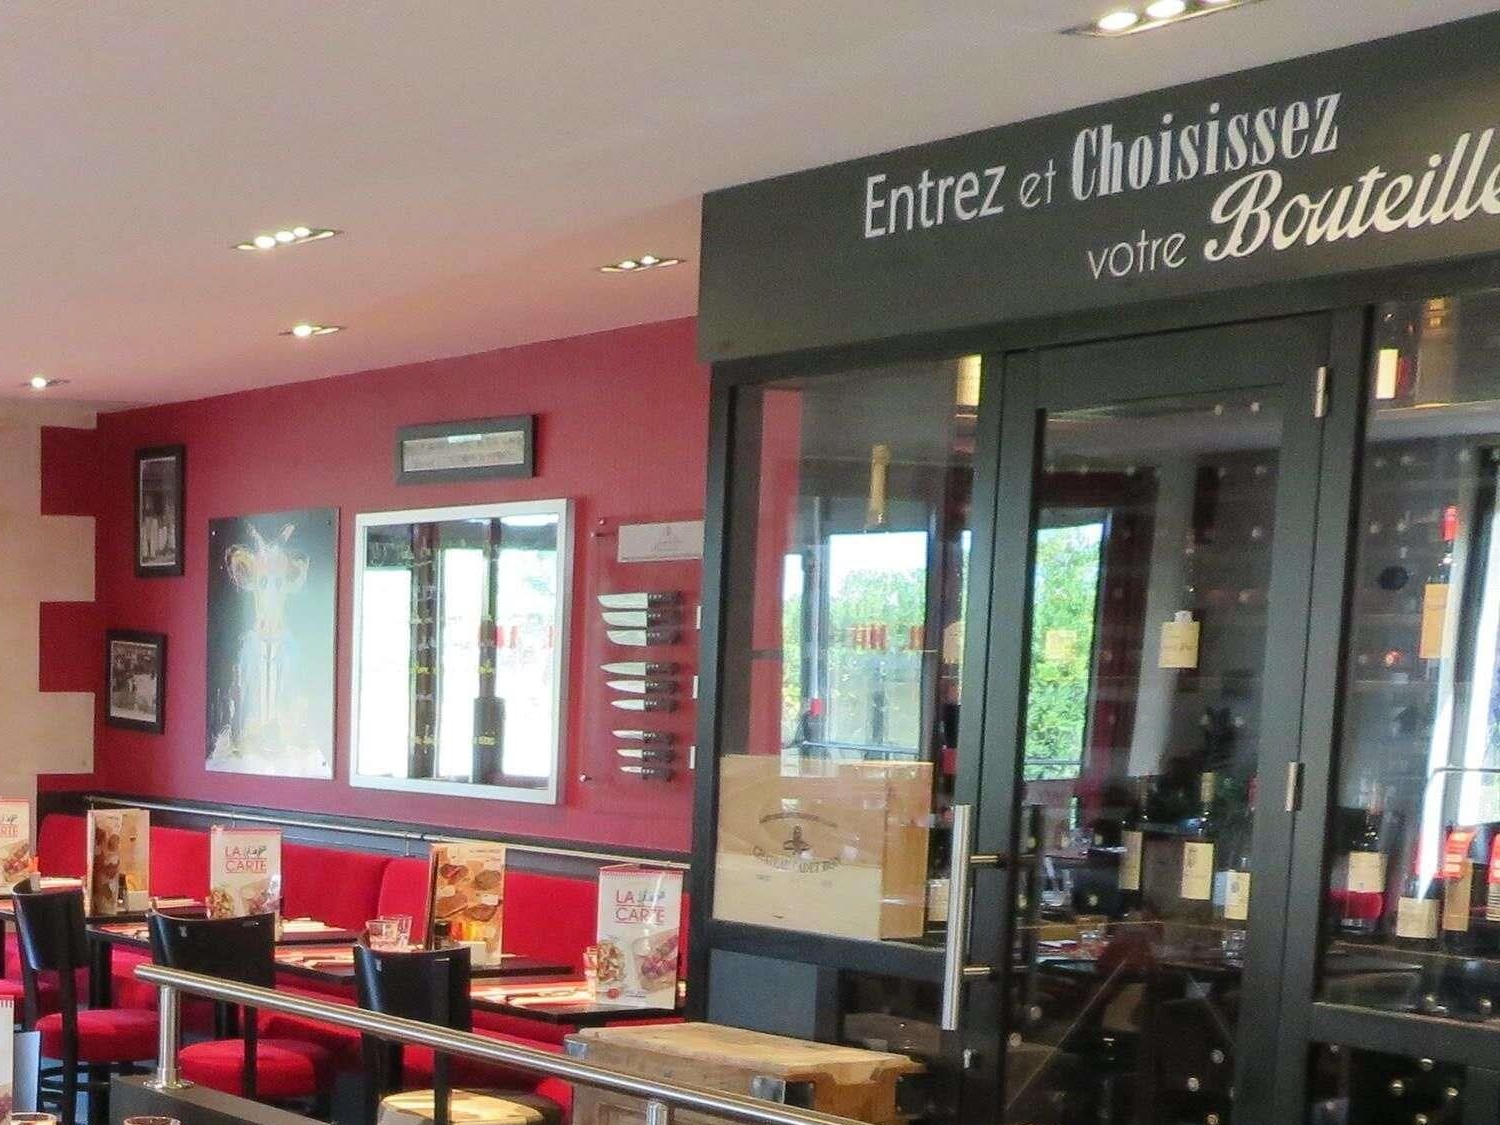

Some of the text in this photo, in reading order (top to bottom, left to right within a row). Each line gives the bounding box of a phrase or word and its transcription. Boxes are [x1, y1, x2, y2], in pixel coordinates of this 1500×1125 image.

[864, 92, 1341, 239] Entrez et Choisissez
[1086, 228, 1188, 280] votre
[225, 846, 242, 857] LA
[225, 860, 267, 871] CARTE
[616, 890, 635, 904] LA
